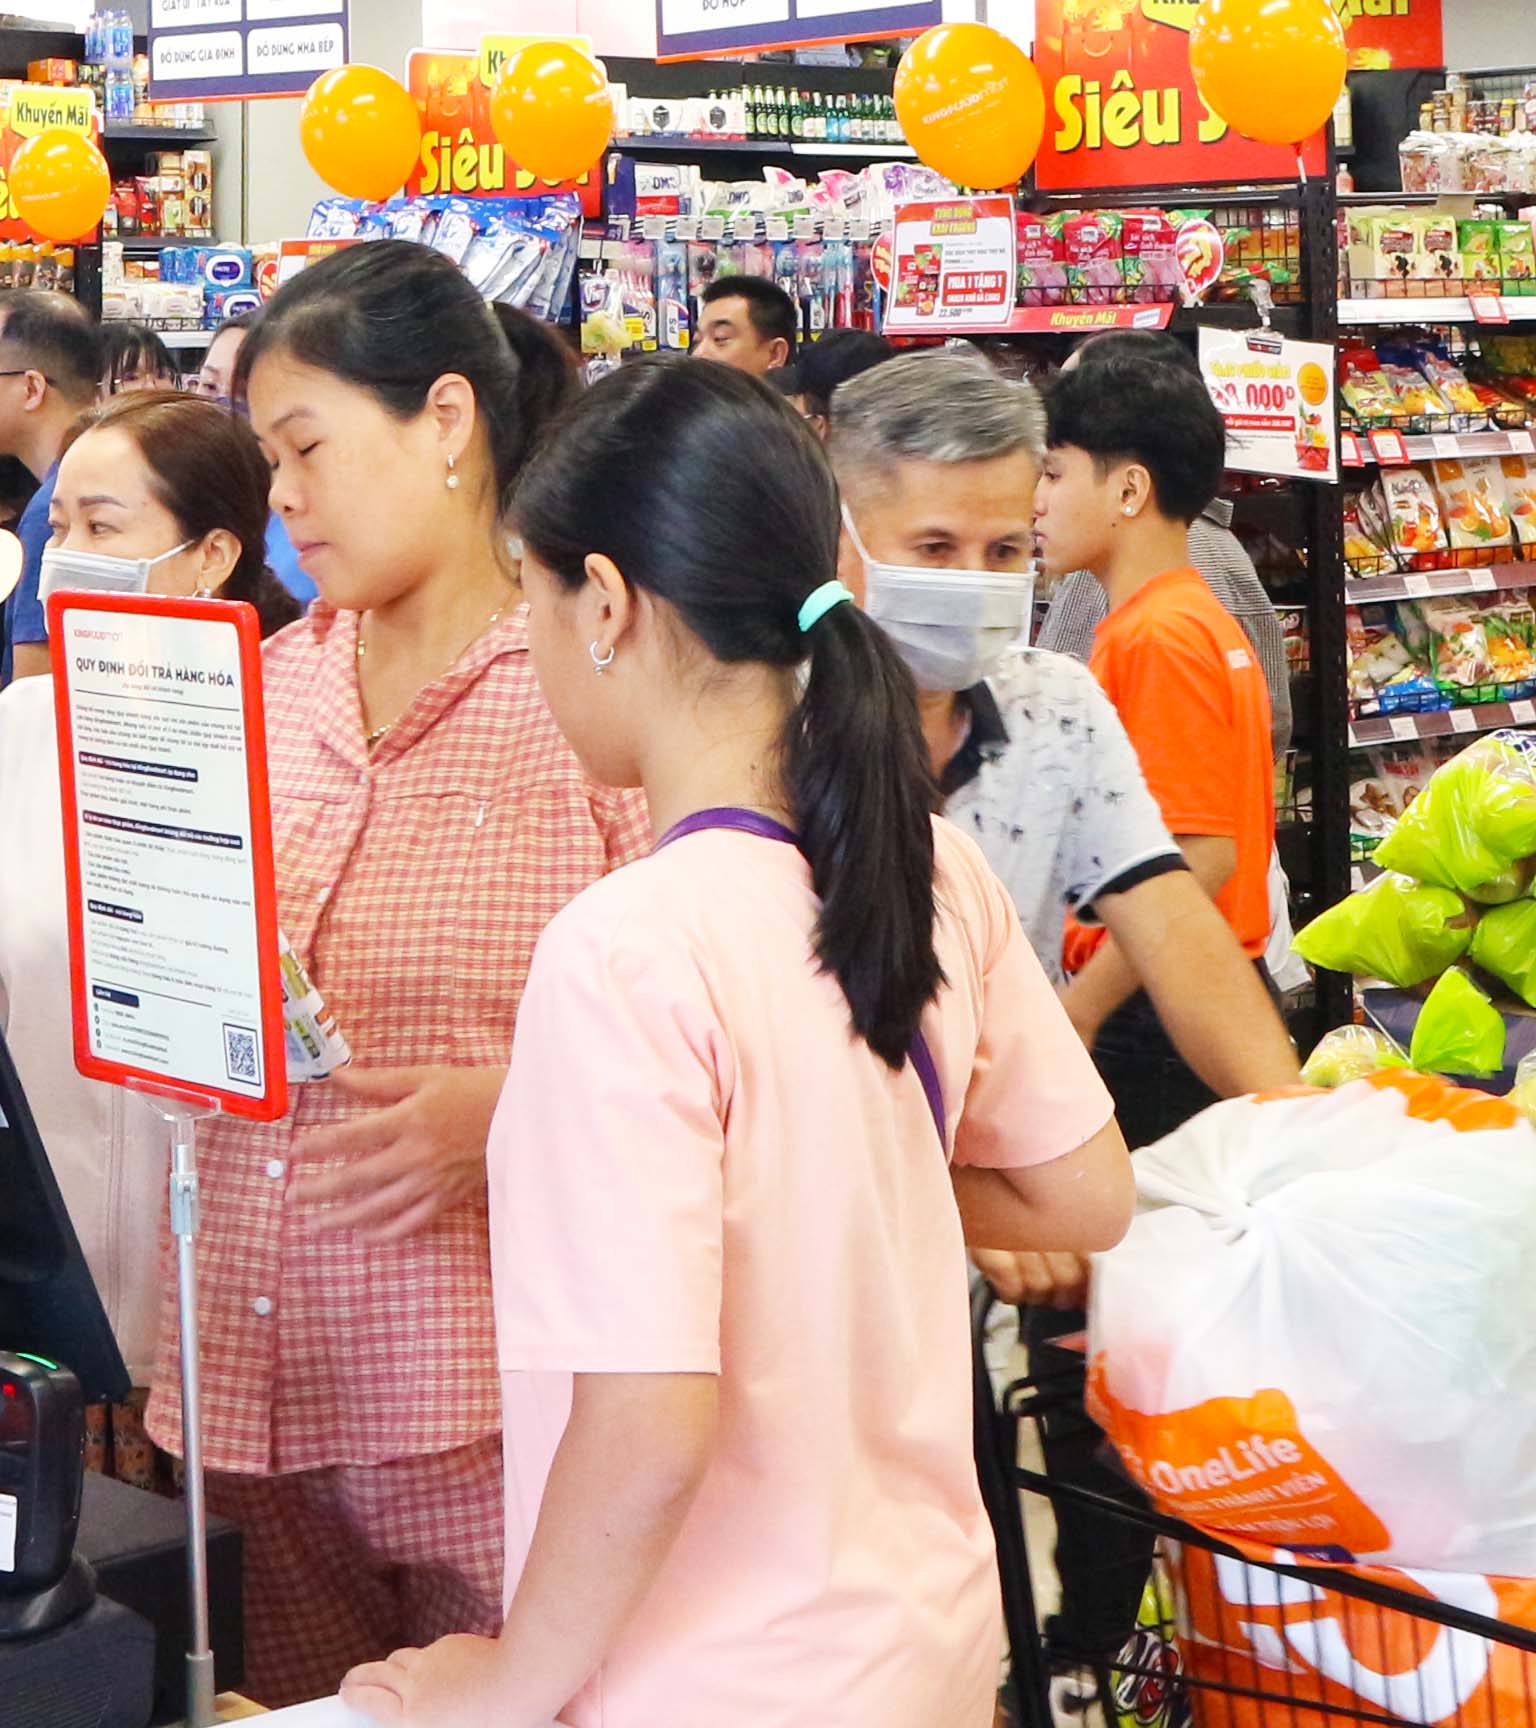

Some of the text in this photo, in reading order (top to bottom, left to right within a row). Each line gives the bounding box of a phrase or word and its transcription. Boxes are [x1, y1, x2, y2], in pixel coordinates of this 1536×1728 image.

[17, 101, 89, 128] Khuyến Mãi
[1055, 69, 1180, 152] Siêu
[420, 128, 504, 194] Siêu
[1051, 311, 1093, 328] Khuyến
[76, 656, 96, 672] QUY
[98, 659, 125, 677] ĐỊNH
[151, 659, 173, 680] TRẢ
[175, 664, 205, 684] HÀNG
[208, 666, 234, 687] HÓA
[1149, 1434, 1303, 1494] OneLife
